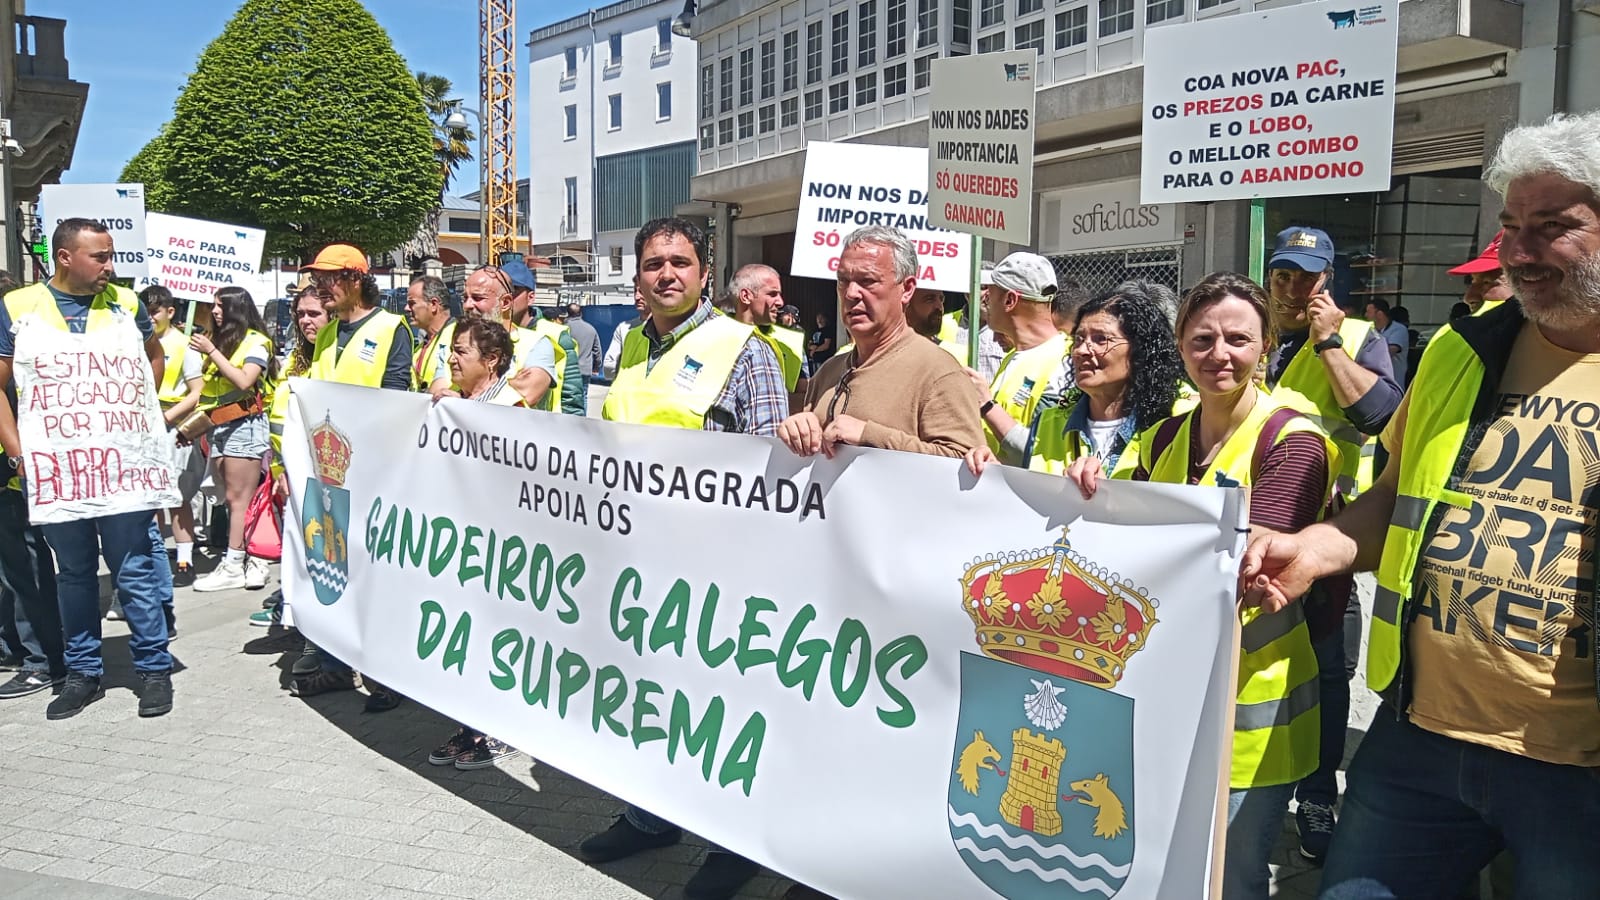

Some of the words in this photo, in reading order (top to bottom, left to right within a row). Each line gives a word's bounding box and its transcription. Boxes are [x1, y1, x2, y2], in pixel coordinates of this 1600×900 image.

[1184, 74, 1225, 92] COA
[1231, 66, 1289, 87] NOVA
[1297, 59, 1346, 79] PAC,
[1152, 104, 1177, 119] OS
[1184, 94, 1263, 116] PREZOS
[1270, 90, 1298, 107] DA
[1305, 80, 1384, 103] CARNE
[931, 110, 954, 129] NON
[957, 110, 981, 129] NOS
[985, 109, 1029, 130] DADES
[1209, 123, 1221, 138] E
[1228, 121, 1242, 136] O
[1250, 114, 1313, 134] LOBO,
[937, 141, 1019, 165] IMPORTANCIA
[1169, 150, 1182, 164] O
[1189, 143, 1270, 164] MELLOR
[1277, 135, 1359, 157] COMBO
[936, 168, 951, 190] SÓ
[953, 173, 1018, 198] QUEREDES
[1163, 172, 1213, 188] PARA
[1219, 170, 1233, 185] O
[1240, 161, 1364, 184] ABANDONO
[808, 182, 852, 200] NON
[858, 186, 902, 204] NOS
[944, 203, 1006, 230] GANANCIA
[168, 236, 195, 249] PAC
[199, 241, 236, 256] PARA
[813, 229, 840, 247] SÓ
[161, 264, 192, 277] NON
[197, 269, 233, 284] PARA
[168, 251, 254, 275] GANDEIROS,
[140, 276, 159, 286] AS
[34, 352, 145, 380] ESTAMOS
[30, 381, 146, 411] AFOGADOS
[44, 412, 92, 438] POR
[99, 411, 150, 433] TANTA
[438, 426, 538, 472] CONCELLO
[548, 447, 578, 481] DA
[588, 454, 826, 520] FONSAGRADA
[519, 481, 587, 525] APOIA
[597, 492, 632, 535] ÓS
[1487, 490, 1518, 503] shake
[1520, 494, 1534, 506] it!
[1536, 498, 1549, 512] dj
[1550, 502, 1573, 515] set
[1421, 559, 1466, 579] dancehall
[1468, 570, 1503, 587] fidget
[1507, 579, 1543, 599] funky
[1544, 588, 1589, 605] jungle
[365, 496, 586, 625] GANDEIROS
[609, 566, 928, 728] GALEGOS
[417, 600, 472, 676] DA
[489, 628, 767, 797] SUPREMA
